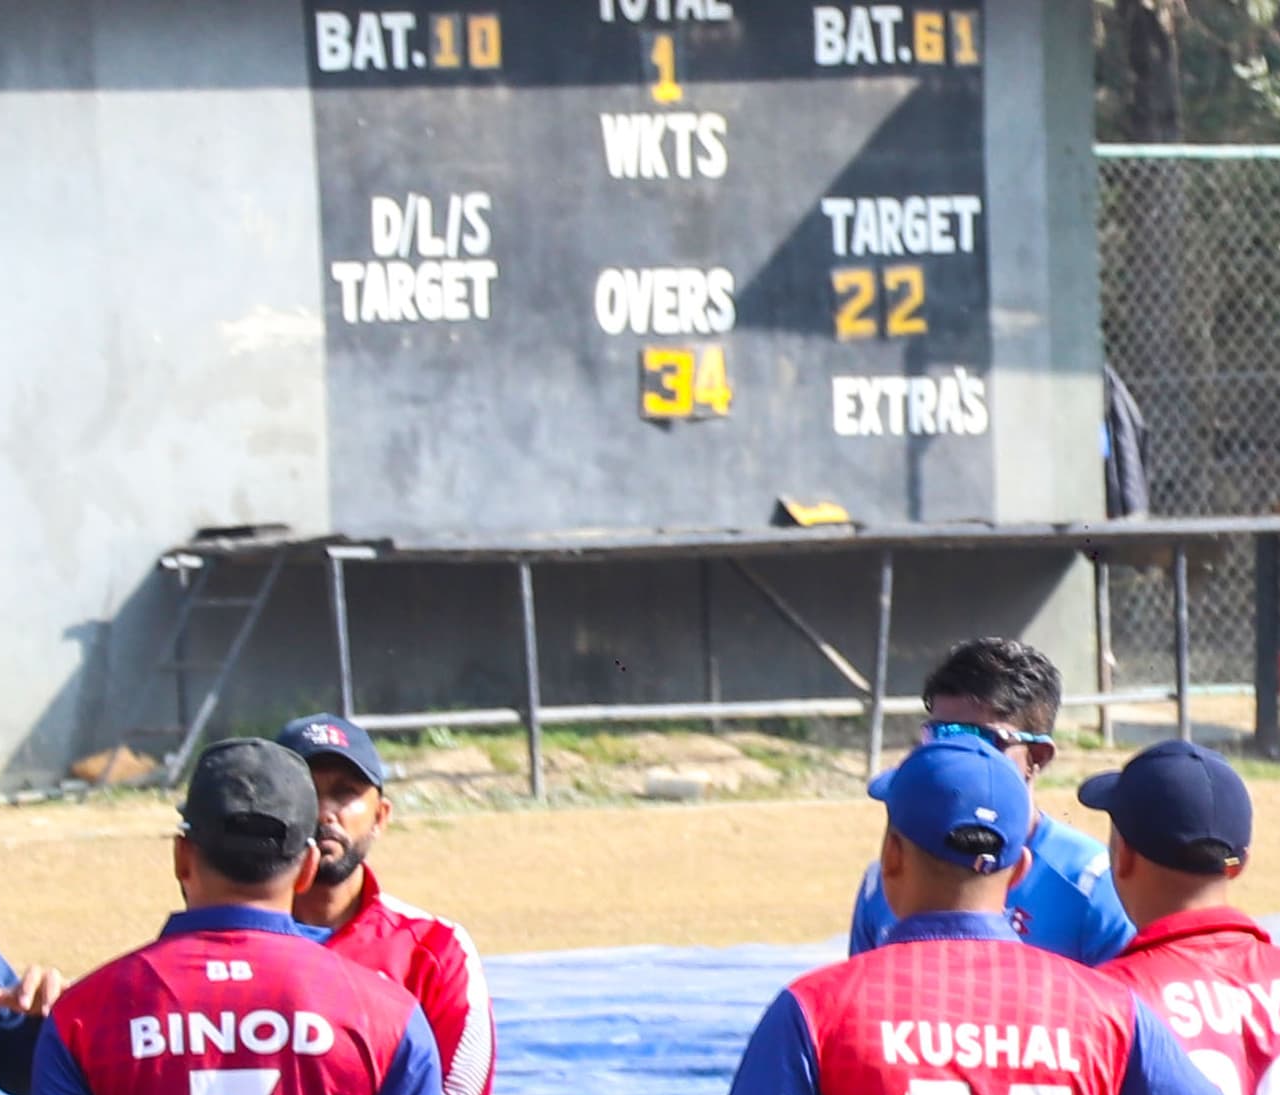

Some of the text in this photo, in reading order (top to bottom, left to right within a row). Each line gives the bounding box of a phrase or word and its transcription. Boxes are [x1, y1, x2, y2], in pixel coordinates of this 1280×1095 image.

[600, 112, 727, 179] WKTS
[371, 193, 491, 258] D/L/S
[822, 196, 981, 257] TARGET
[332, 260, 497, 324] TARGET
[595, 268, 735, 334] OVERS
[832, 267, 927, 341] 22
[641, 346, 733, 420] 34
[206, 960, 253, 982] BB
[129, 1009, 335, 1060] BINOD
[880, 1020, 1081, 1073] KUSHAL
